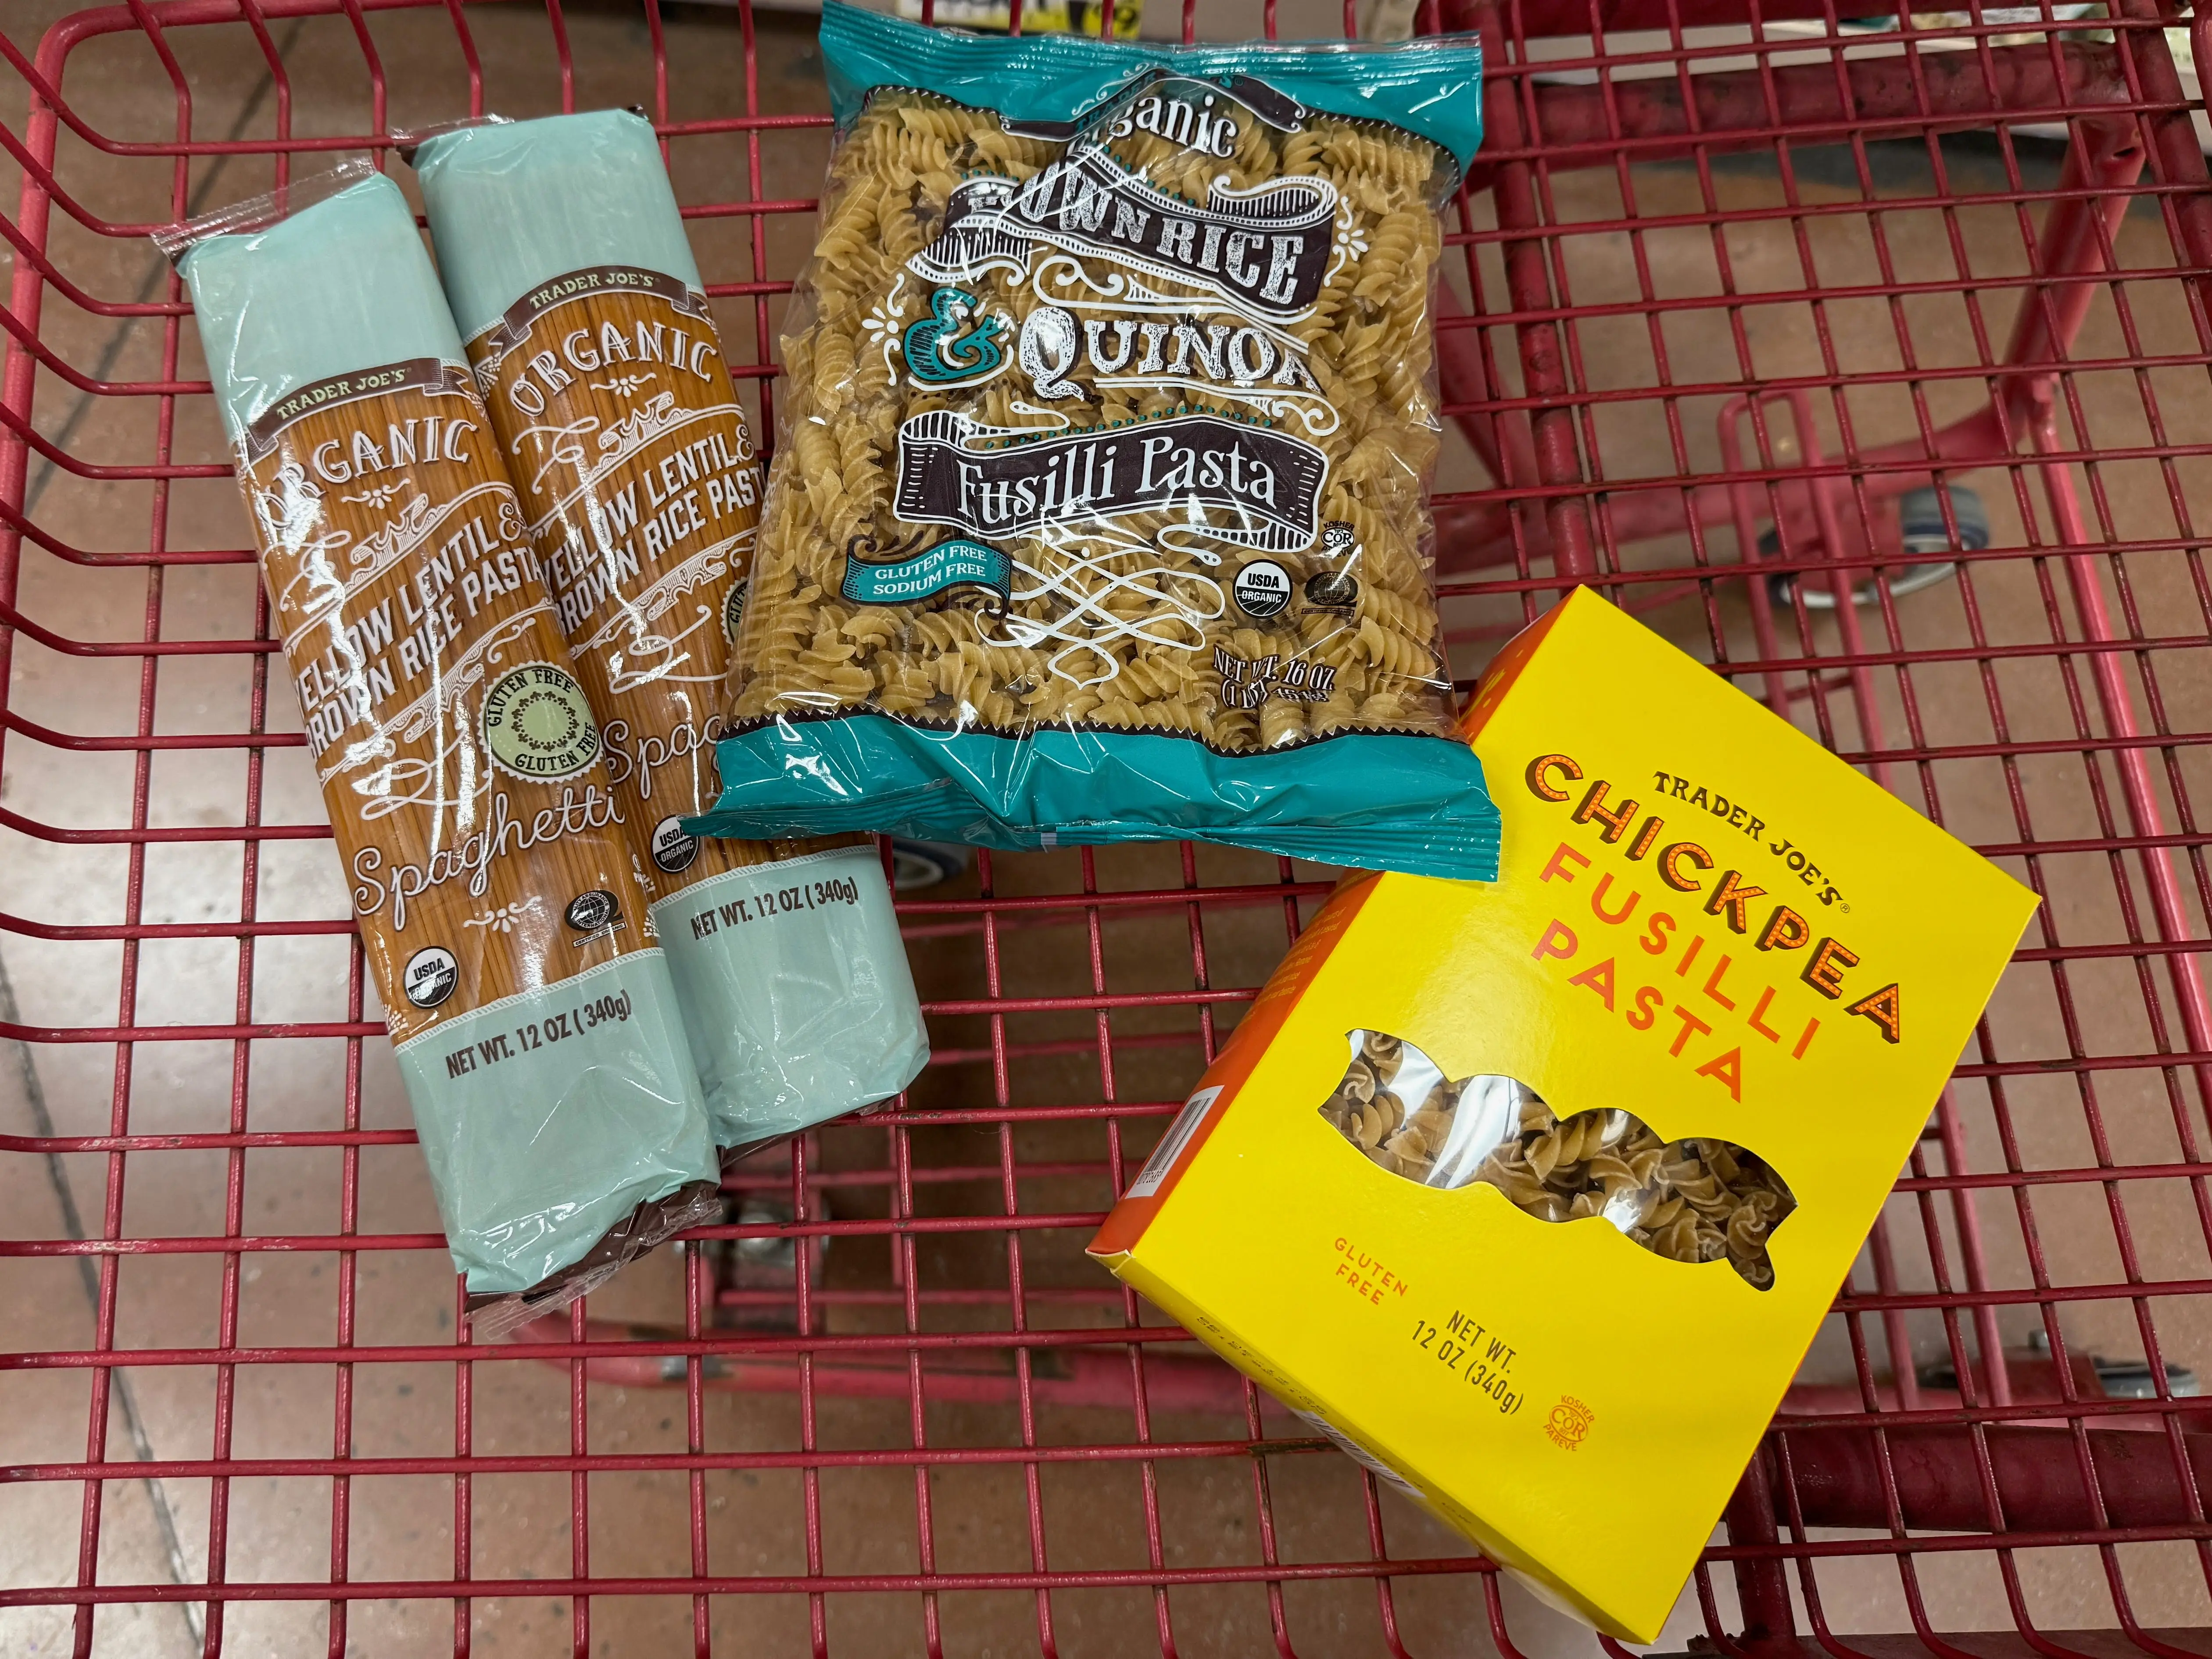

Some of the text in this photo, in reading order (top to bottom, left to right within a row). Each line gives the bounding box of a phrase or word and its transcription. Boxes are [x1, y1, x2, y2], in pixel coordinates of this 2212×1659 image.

[1156, 217, 1303, 305] RICE
[530, 274, 602, 309] TRADER
[509, 319, 719, 417] ORGANIC
[1019, 306, 1323, 401] QUINOA
[277, 378, 352, 420] TRADER
[643, 433, 738, 510] LENTIL
[736, 424, 755, 461] &
[956, 436, 1276, 525] Fusilli Pasta
[643, 488, 706, 562] RICE
[706, 467, 767, 519] PAST
[1323, 521, 1355, 531] KOSHER
[1323, 532, 1352, 545] COR
[398, 516, 500, 626] LENTIL
[498, 502, 522, 541] &
[873, 564, 986, 595] SODIUM FREE
[874, 545, 987, 580] GLUTEN FREE
[1247, 573, 1280, 589] USDA
[397, 595, 463, 682] RICE
[461, 546, 544, 619] PASTA
[1241, 590, 1282, 604] ORGANIC
[1213, 645, 1246, 683] NET
[1282, 659, 1306, 685] 16
[1309, 665, 1336, 690] OZ
[487, 669, 573, 727] GLUTEN FREE
[515, 722, 596, 771] GLUTEN FREE
[1653, 771, 1765, 841] TRADER
[353, 787, 626, 932] Spaghetti
[660, 840, 694, 863] ORGANIC
[691, 905, 718, 940] NET
[719, 899, 754, 926] WT.
[754, 893, 777, 917] 12
[779, 887, 804, 911] OZ
[1525, 754, 1899, 1044] CHICKPEA
[413, 957, 445, 980] USDA
[1539, 842, 1820, 1060] FUSILLI
[1531, 919, 1740, 1102] PASTA
[445, 1047, 479, 1079] NET
[478, 1035, 515, 1065] WT.
[516, 1024, 543, 1053] 12
[544, 1012, 573, 1040] OZ
[1335, 1237, 1408, 1297] GLUTEN
[1335, 1264, 1384, 1305] FREE
[1411, 1320, 1522, 1415] 12 OZ (340g)
[1446, 1310, 1516, 1373] NET WT.
[1543, 1424, 1577, 1451] PAREVE
[1552, 1408, 1585, 1441] COR
[1561, 1395, 1595, 1423] KOSHER
